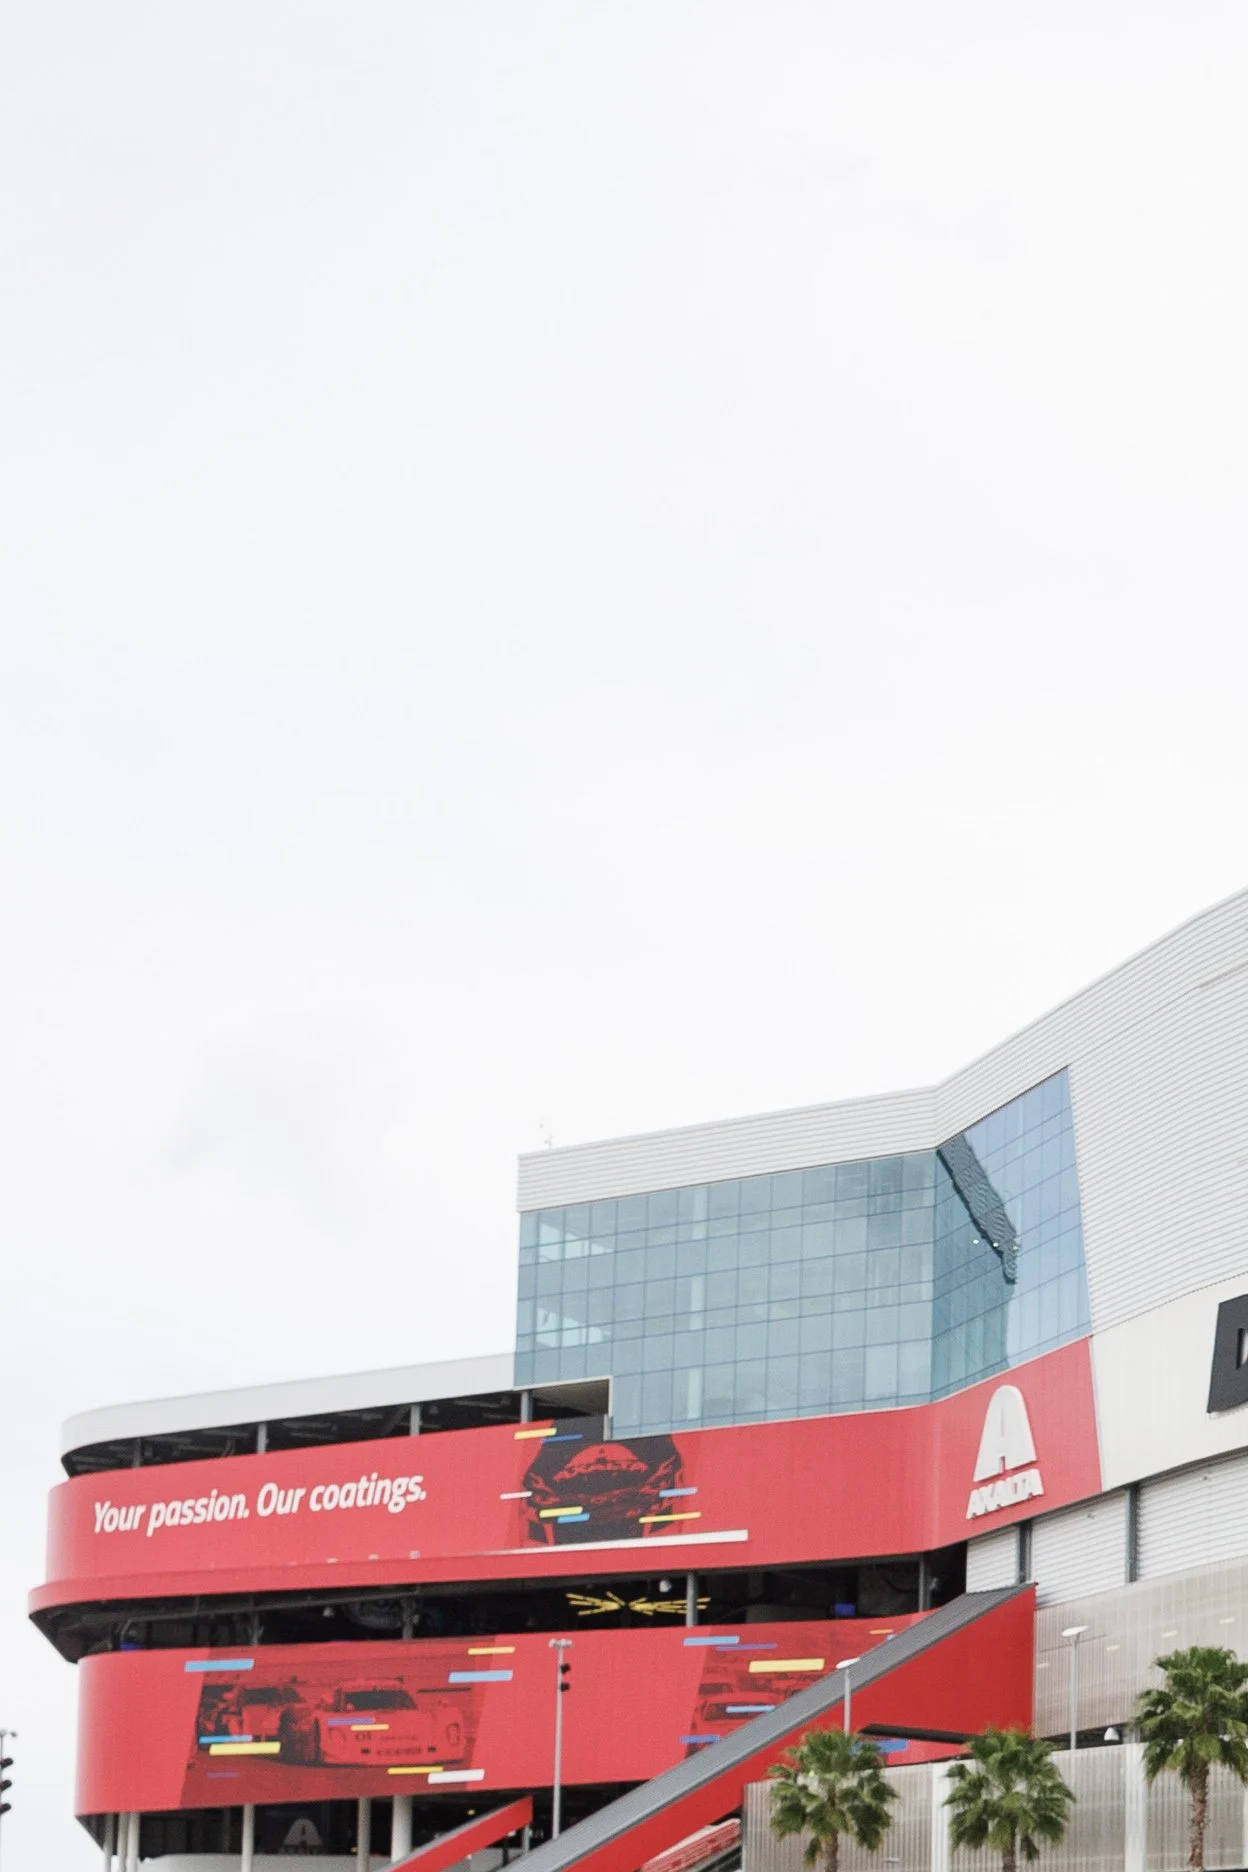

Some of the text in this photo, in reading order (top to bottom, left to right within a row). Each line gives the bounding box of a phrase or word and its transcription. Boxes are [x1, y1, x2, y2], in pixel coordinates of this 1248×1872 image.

[94, 1472, 427, 1537] Your passion. Our coatings.
[965, 1467, 1045, 1520] AXALTA
